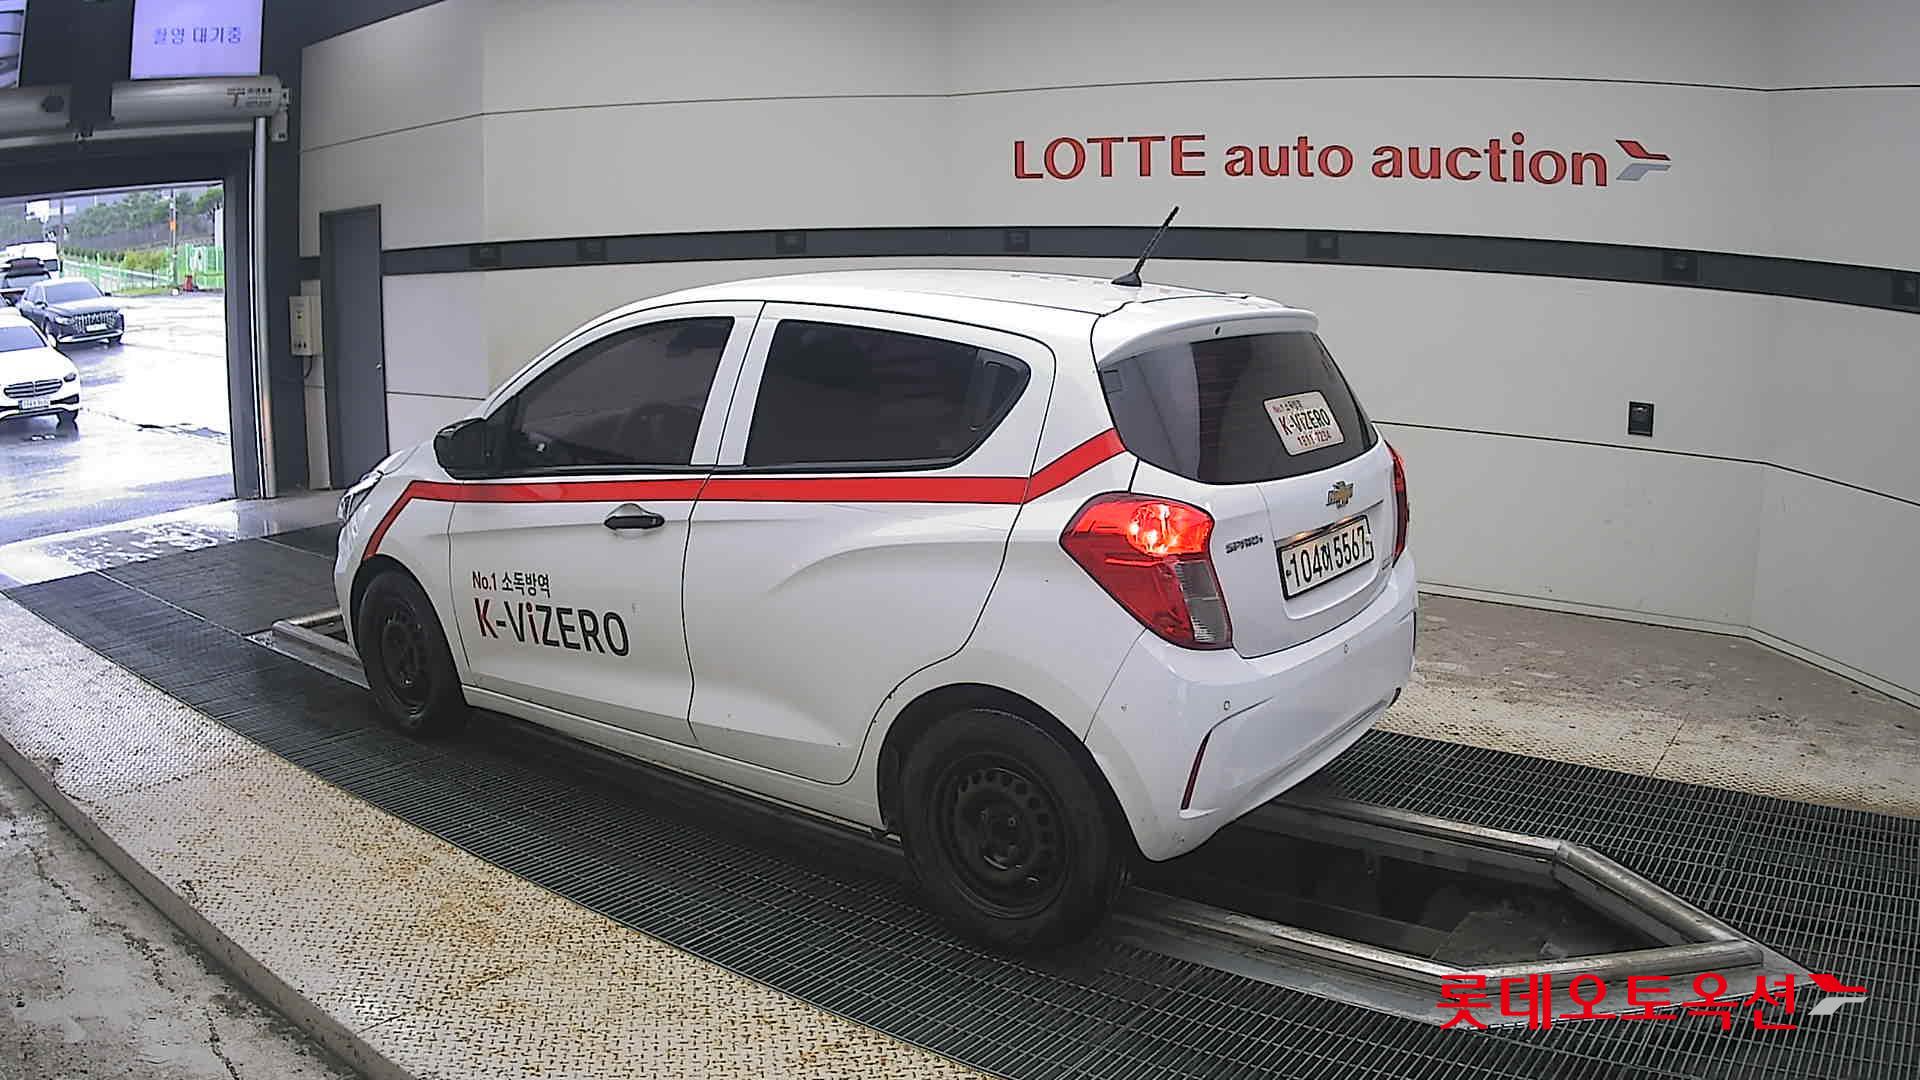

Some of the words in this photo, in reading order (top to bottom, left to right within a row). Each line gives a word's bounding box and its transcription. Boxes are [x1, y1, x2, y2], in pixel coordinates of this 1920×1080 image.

[193, 26, 241, 43] 대기중
[1014, 134, 1207, 180] LOTTE
[1224, 136, 1354, 177] auto
[1370, 132, 1608, 187] auction
[472, 571, 497, 591] No.1
[501, 571, 551, 599] 소독방역
[474, 597, 630, 657] K-ViZERO
